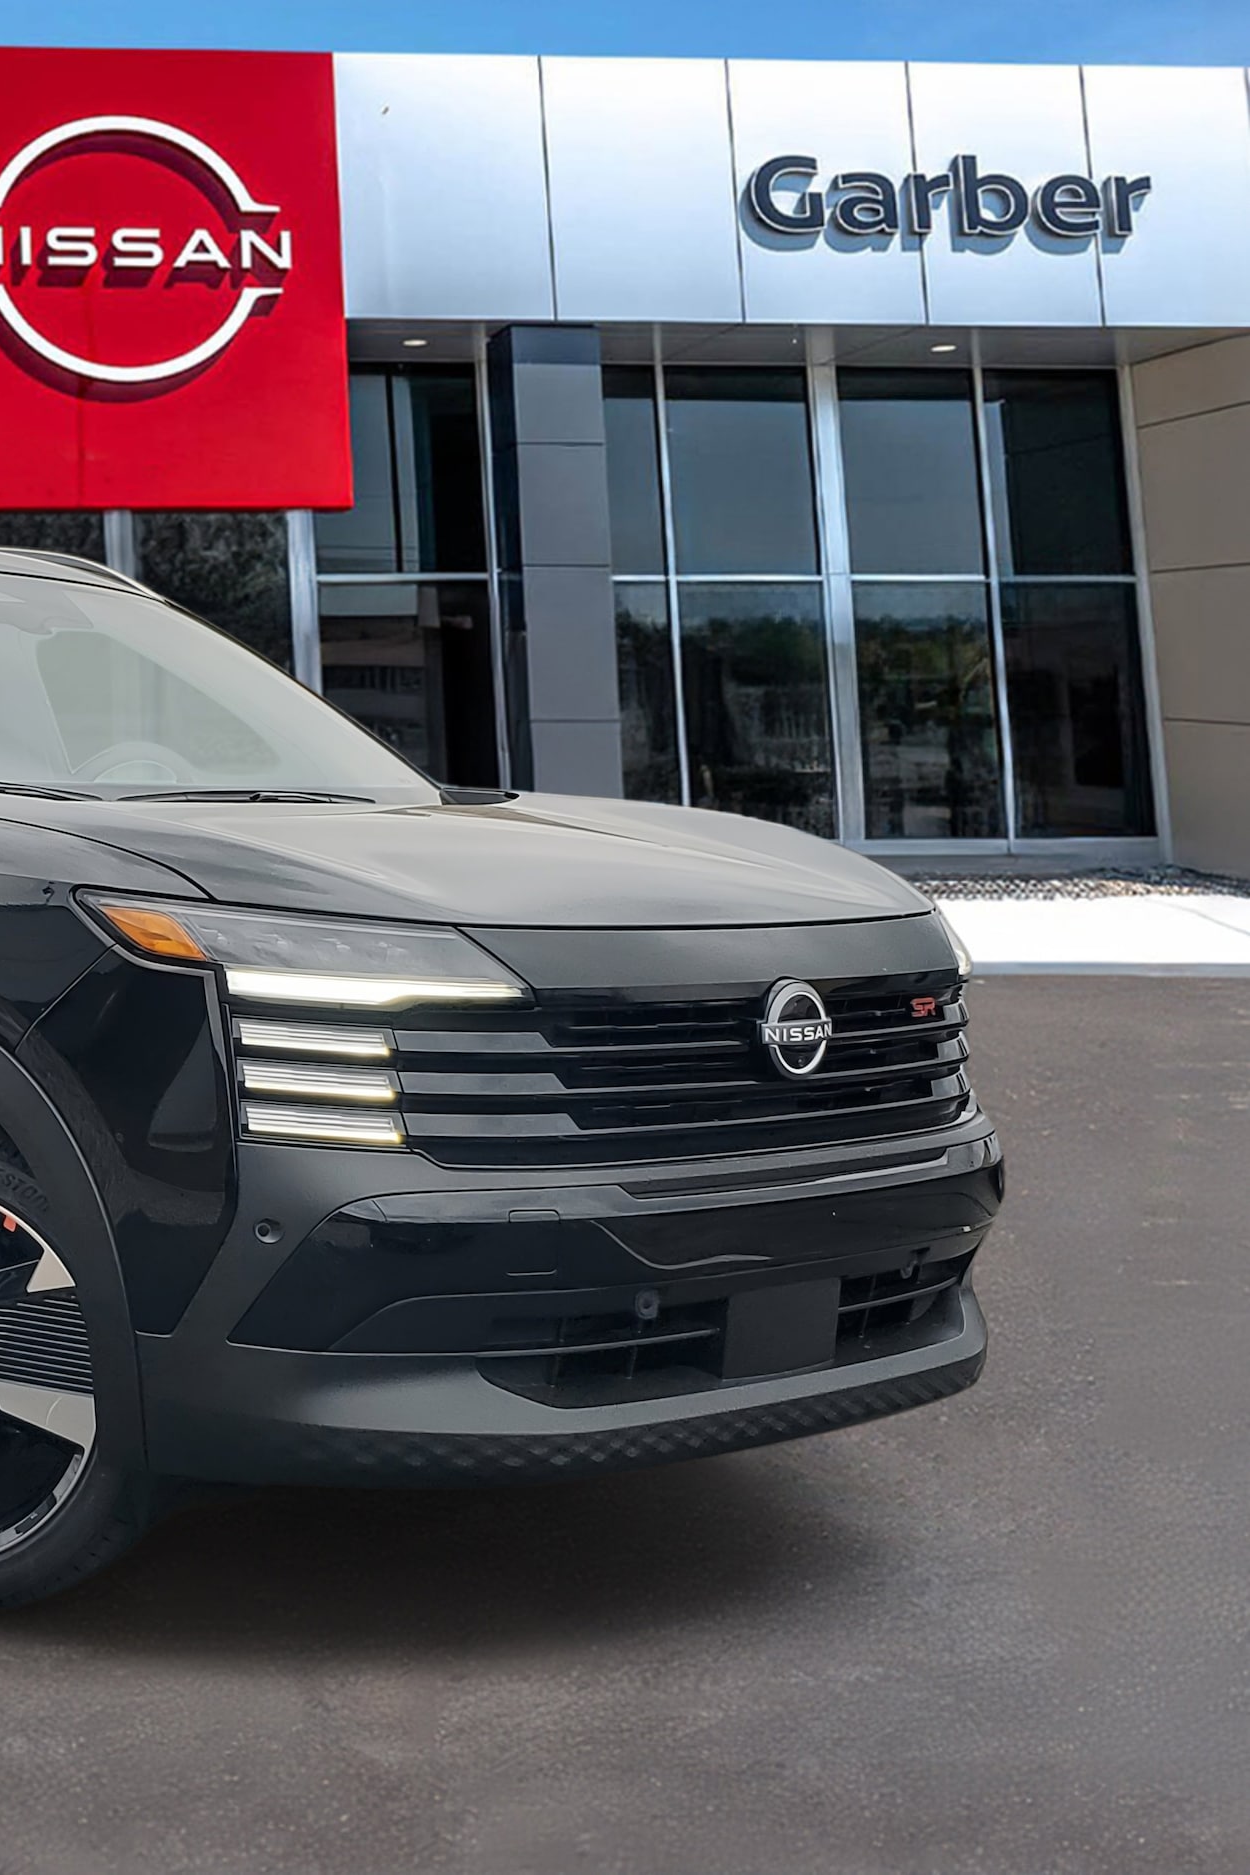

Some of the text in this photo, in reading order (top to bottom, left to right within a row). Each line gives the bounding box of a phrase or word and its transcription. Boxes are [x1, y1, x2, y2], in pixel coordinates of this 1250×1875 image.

[749, 154, 1151, 237] Garber
[910, 997, 936, 1018] SR
[765, 1023, 832, 1042] NISSAN
